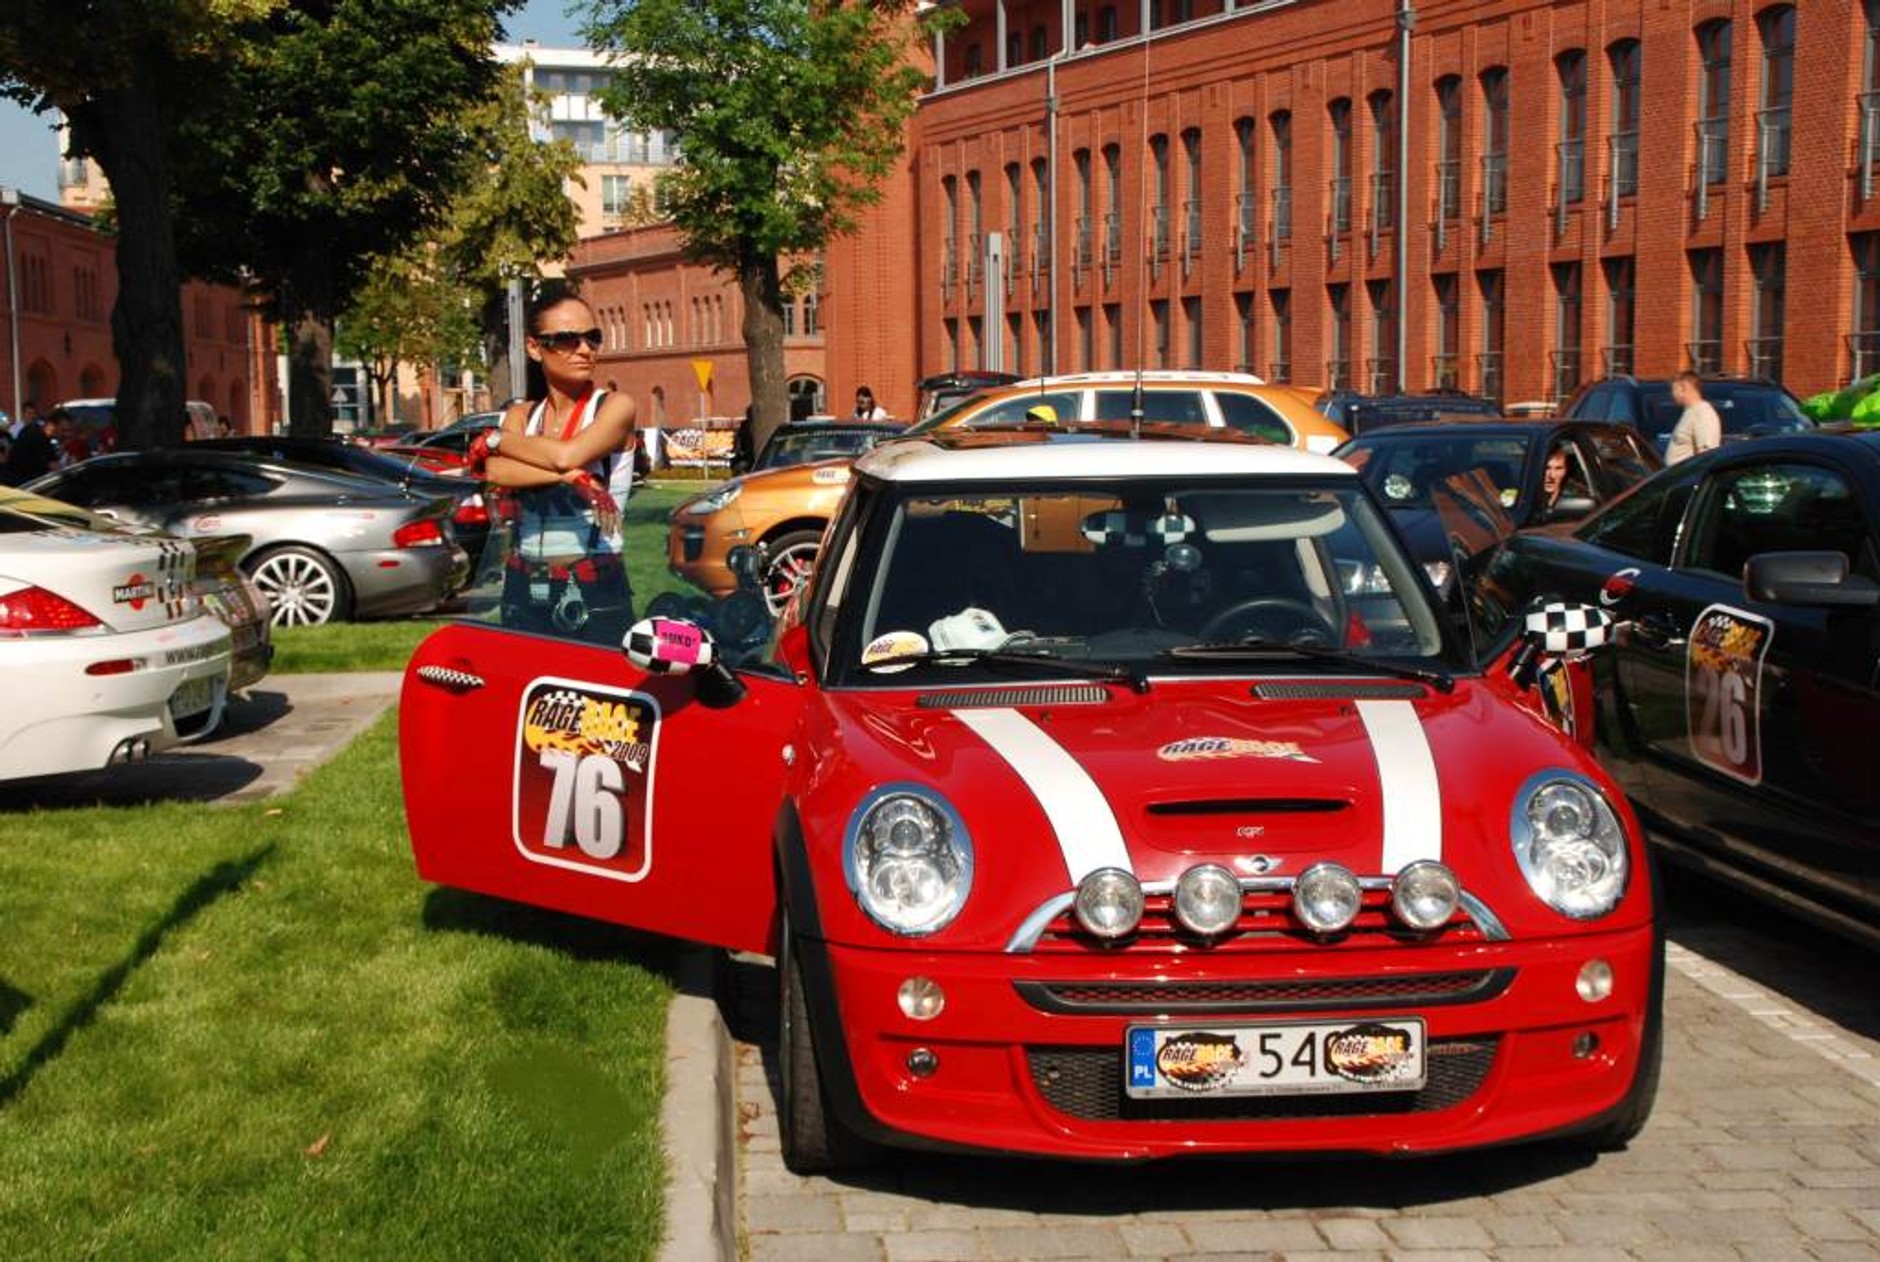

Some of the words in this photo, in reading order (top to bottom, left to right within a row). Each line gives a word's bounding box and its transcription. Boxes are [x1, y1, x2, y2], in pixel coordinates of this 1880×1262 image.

[530, 699, 586, 733] RAGE
[611, 740, 649, 763] 2009
[539, 748, 625, 860] 76
[1134, 1065, 1153, 1080] PL
